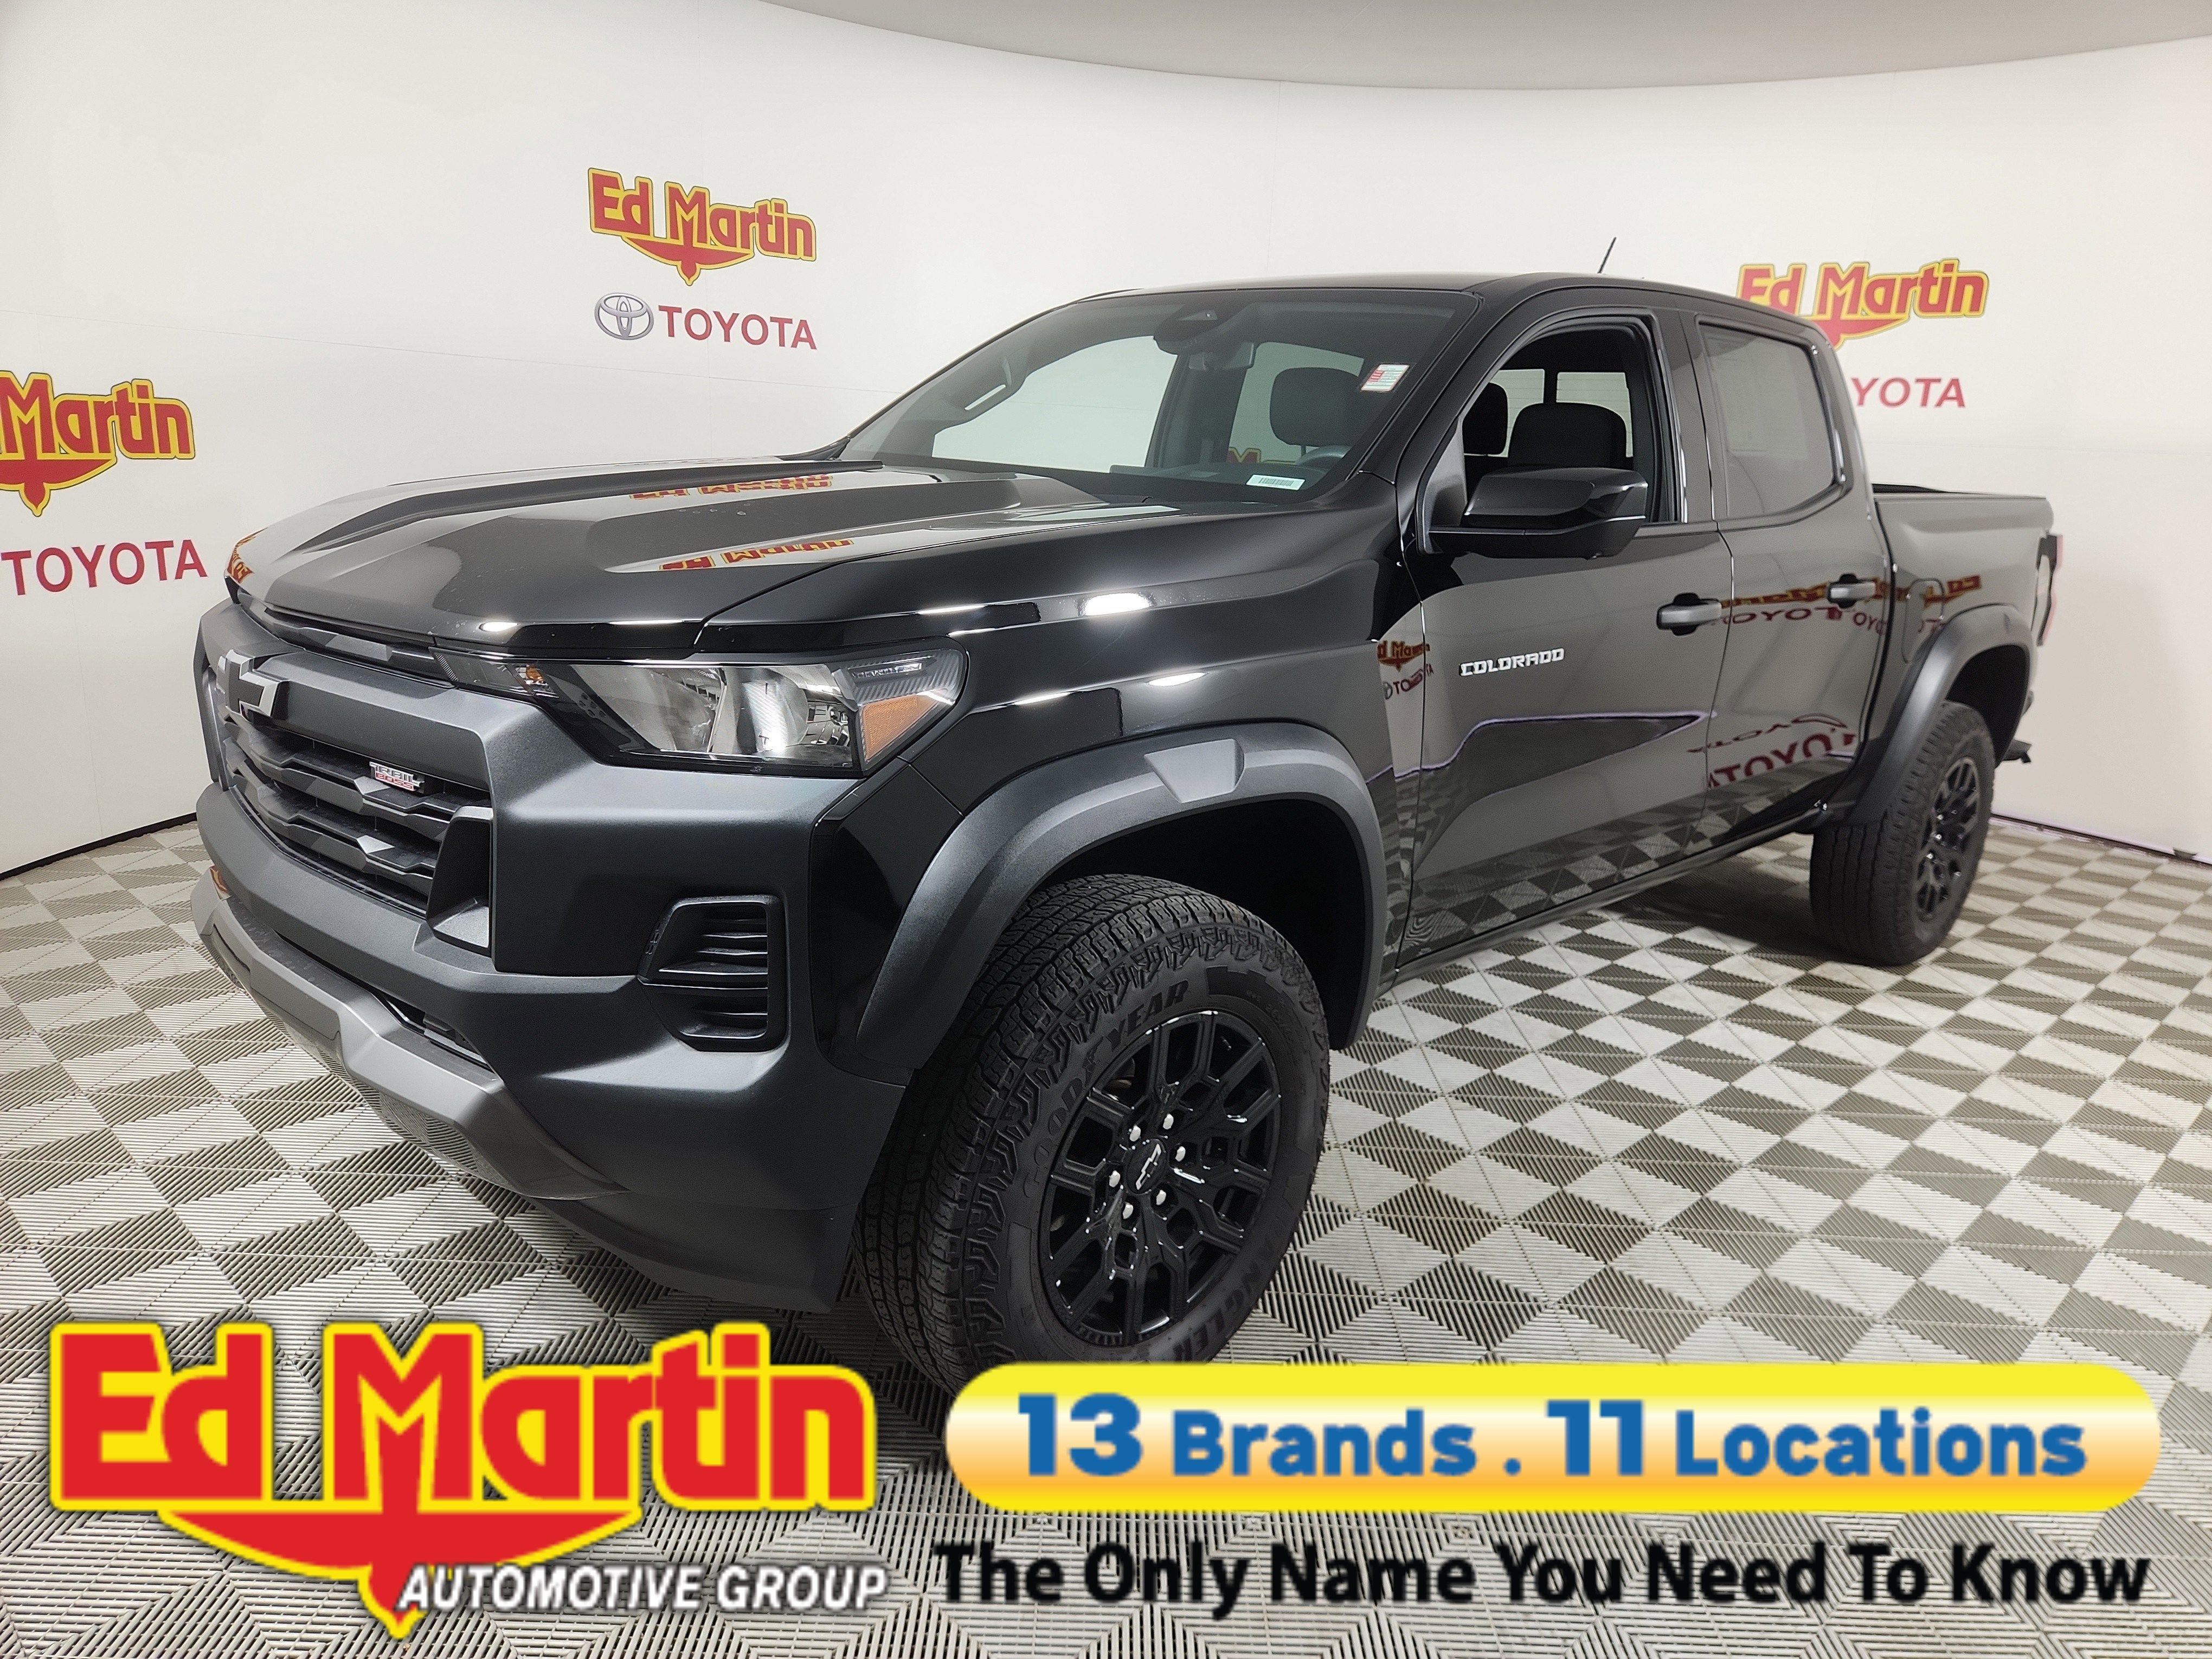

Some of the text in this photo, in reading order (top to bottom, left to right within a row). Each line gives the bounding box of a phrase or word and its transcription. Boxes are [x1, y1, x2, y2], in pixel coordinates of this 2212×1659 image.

[591, 172, 814, 258] Ed Martin
[1819, 262, 1985, 316] Martin
[658, 305, 818, 350] TOYOTA
[1850, 377, 1965, 408] YOTA
[0, 376, 191, 455] Martin
[1, 539, 208, 596] TOYOTA
[1459, 648, 1565, 677] COLORADO
[369, 761, 425, 788] TRAIL
[375, 771, 417, 792] BOSS
